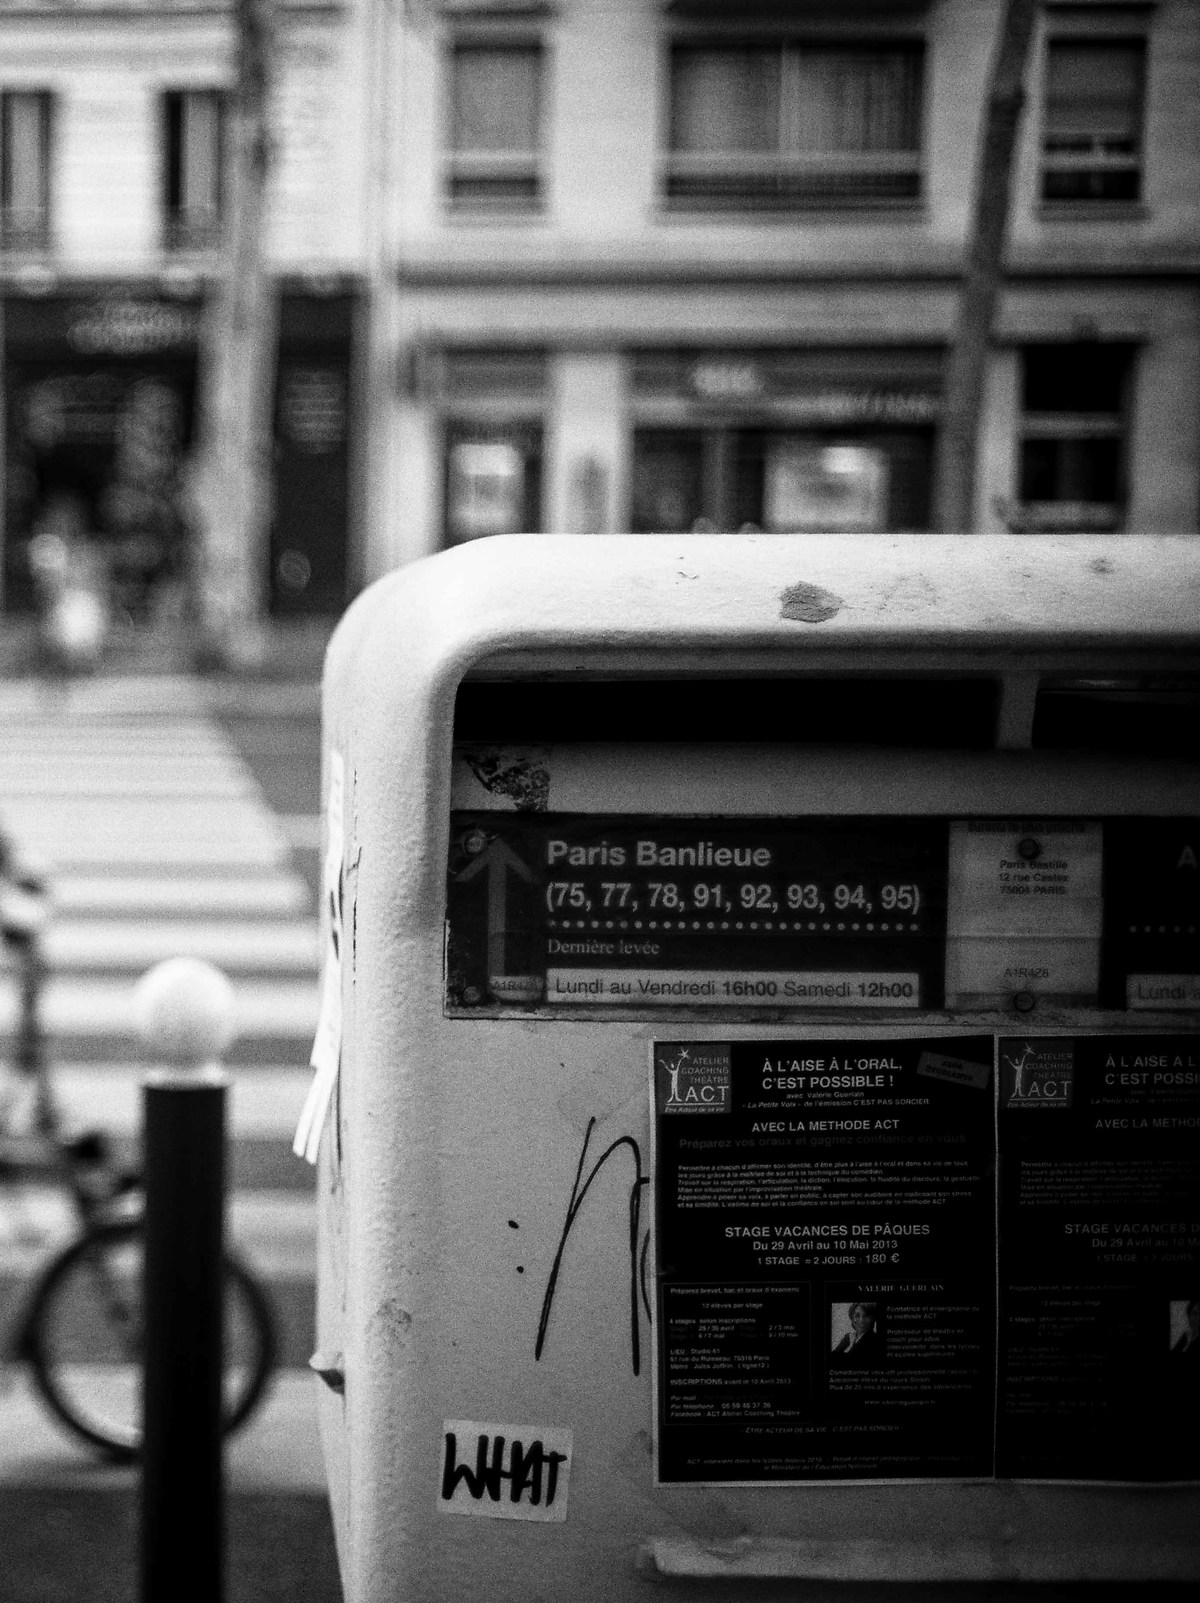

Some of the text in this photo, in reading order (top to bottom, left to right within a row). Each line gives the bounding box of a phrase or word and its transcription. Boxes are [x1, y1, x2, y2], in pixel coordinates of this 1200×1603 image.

[548, 840, 771, 867] Paris Banlieue
[1176, 845, 1200, 869] A
[1000, 860, 1025, 869] Paris
[1033, 885, 1066, 894] PARIS
[546, 882, 920, 915] (75, 77, 78, 91, 92, 93, 94, 95)
[548, 939, 660, 955] Dernière levée
[556, 978, 913, 998] Lundi au Vendredi 16h00 Samedi 12h00
[1138, 984, 1185, 999] Lundi
[693, 1057, 729, 1065] ATELIER
[1037, 1052, 1073, 1060] ATELIER
[1120, 1055, 1168, 1067] L'AISE
[681, 1067, 729, 1075] COACHING
[762, 1057, 902, 1073] À L'AISE À L'ORAL,
[762, 1077, 805, 1089] C'EST
[810, 1075, 884, 1088] POSSIBLE
[1105, 1072, 1200, 1085] C'EST POSSI
[685, 1085, 729, 1102] ACT
[1027, 1081, 1072, 1097] ACT
[877, 1099, 893, 1107] PAS
[751, 1121, 785, 1132] AVEC
[789, 1121, 805, 1132] LA
[874, 1119, 899, 1130] ACT
[1095, 1118, 1128, 1129] AVEC
[1132, 1118, 1148, 1129] LA
[725, 1224, 929, 1238] STAGE VACANCES DE PÂQUES
[1064, 1223, 1109, 1234] STAGE
[1113, 1223, 1187, 1234] VACANCES
[752, 1239, 897, 1251] Du 29 Avril au 10 Mai 2013
[1092, 1238, 1108, 1248] Du
[1110, 1238, 1123, 1248] 29
[1126, 1238, 1152, 1248] Avril
[1172, 1238, 1184, 1248] 10
[757, 1256, 762, 1266] 1
[765, 1256, 799, 1266] STAGE
[813, 1256, 820, 1265] 2
[821, 1255, 856, 1265] JOURS
[865, 1253, 887, 1264] 180
[890, 1253, 900, 1264] €
[1104, 1254, 1137, 1263] STAGE
[442, 1432, 568, 1508] WHAT
